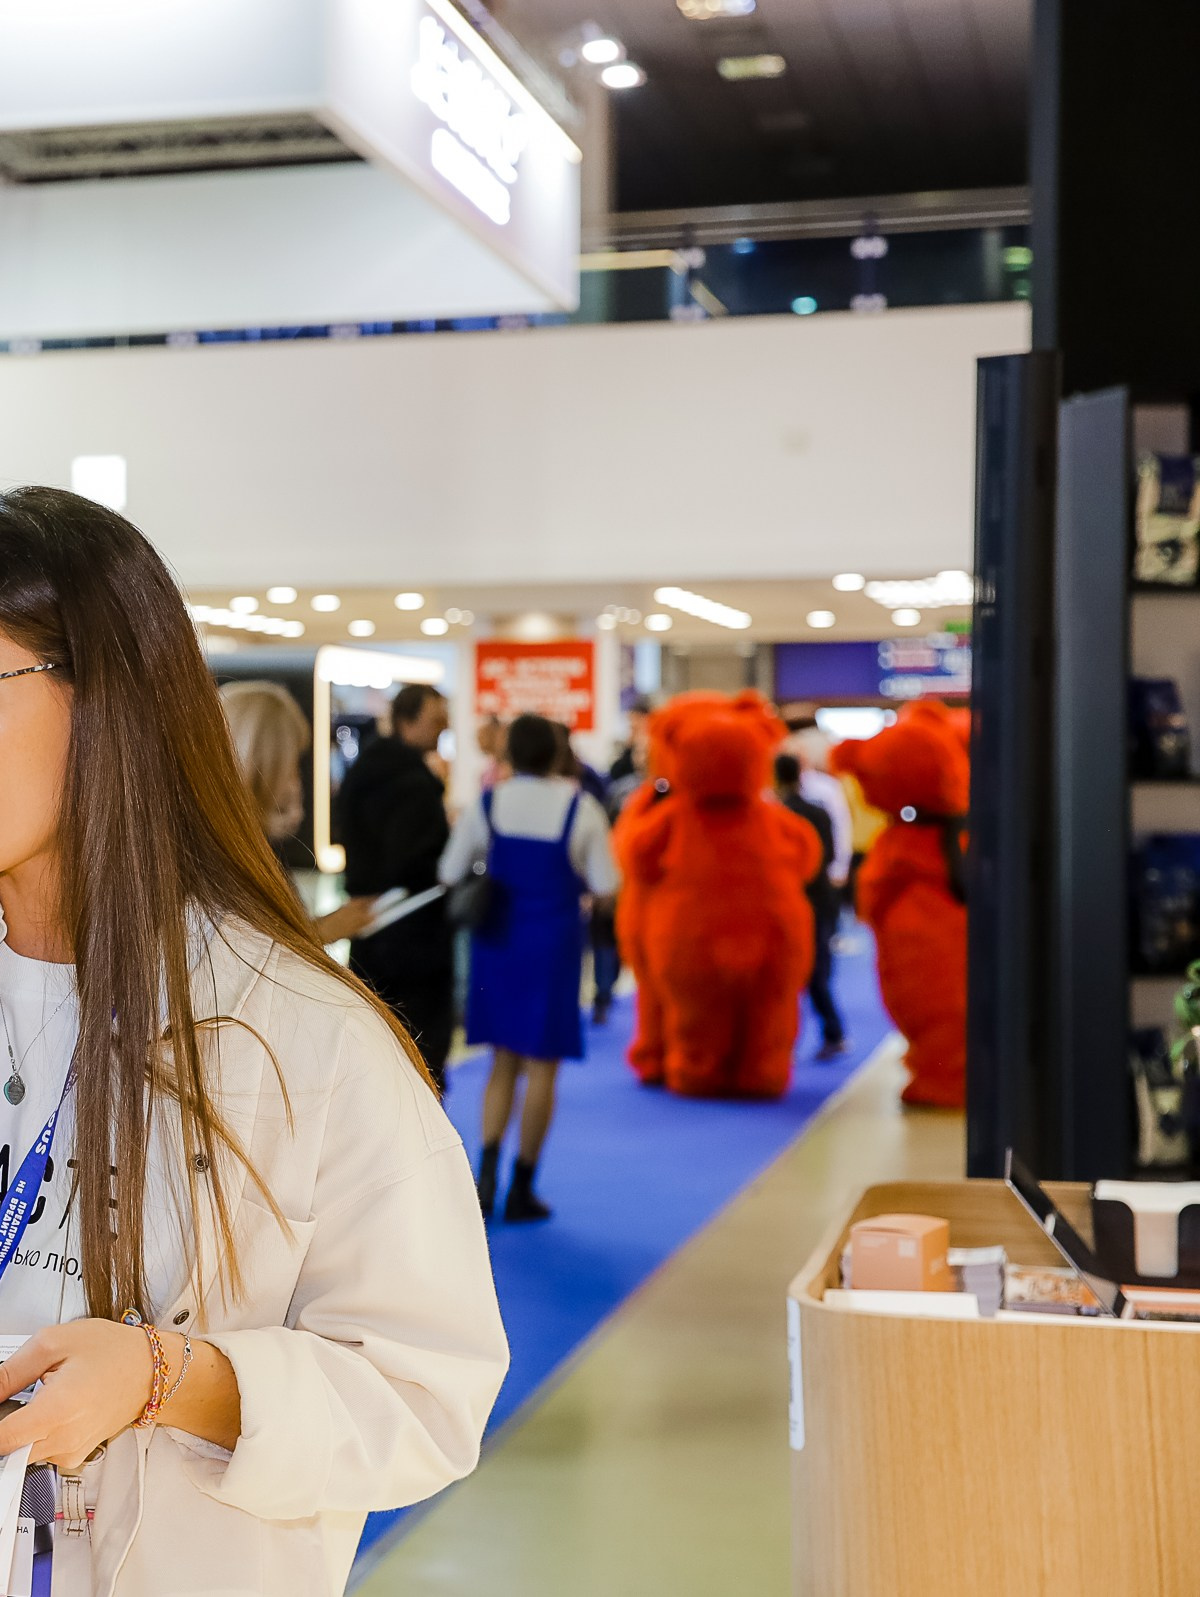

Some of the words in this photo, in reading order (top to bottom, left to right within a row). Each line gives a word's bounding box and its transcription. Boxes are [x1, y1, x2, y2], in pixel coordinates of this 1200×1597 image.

[15, 1180, 27, 1194] НЕ
[0, 1198, 19, 1236] ВРЕДИТ
[9, 1247, 41, 1268] ЬКО
[16, 1525, 29, 1534] НА
